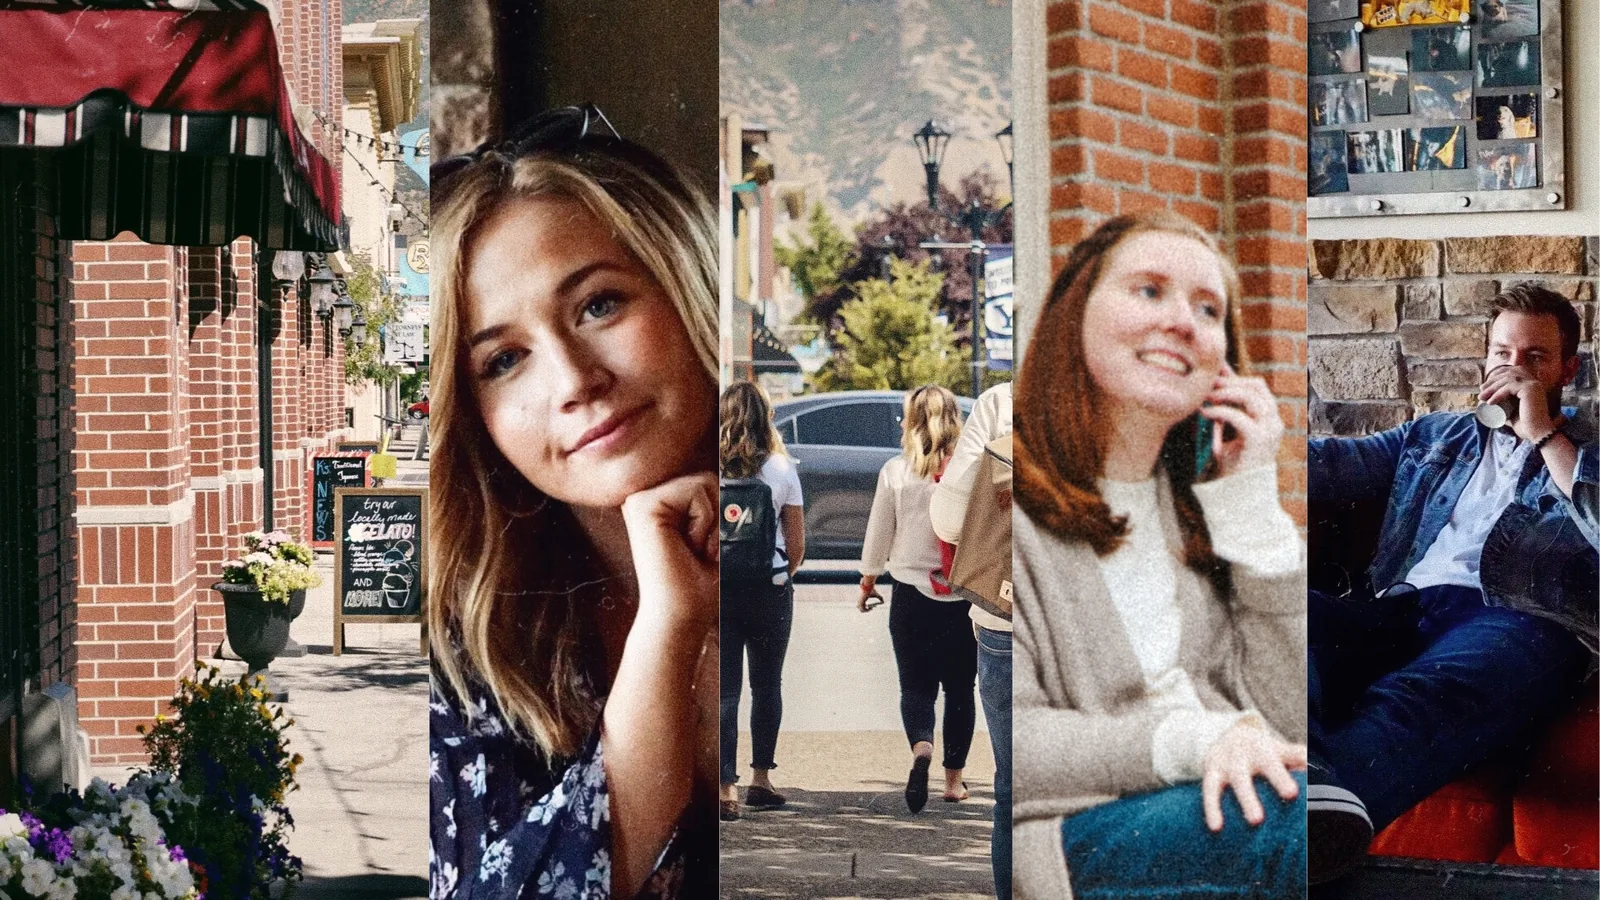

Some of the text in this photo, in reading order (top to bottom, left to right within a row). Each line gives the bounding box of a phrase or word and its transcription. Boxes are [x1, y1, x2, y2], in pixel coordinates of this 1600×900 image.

[363, 498, 381, 514] try
[347, 511, 416, 524] locally made
[353, 578, 373, 587] AND
